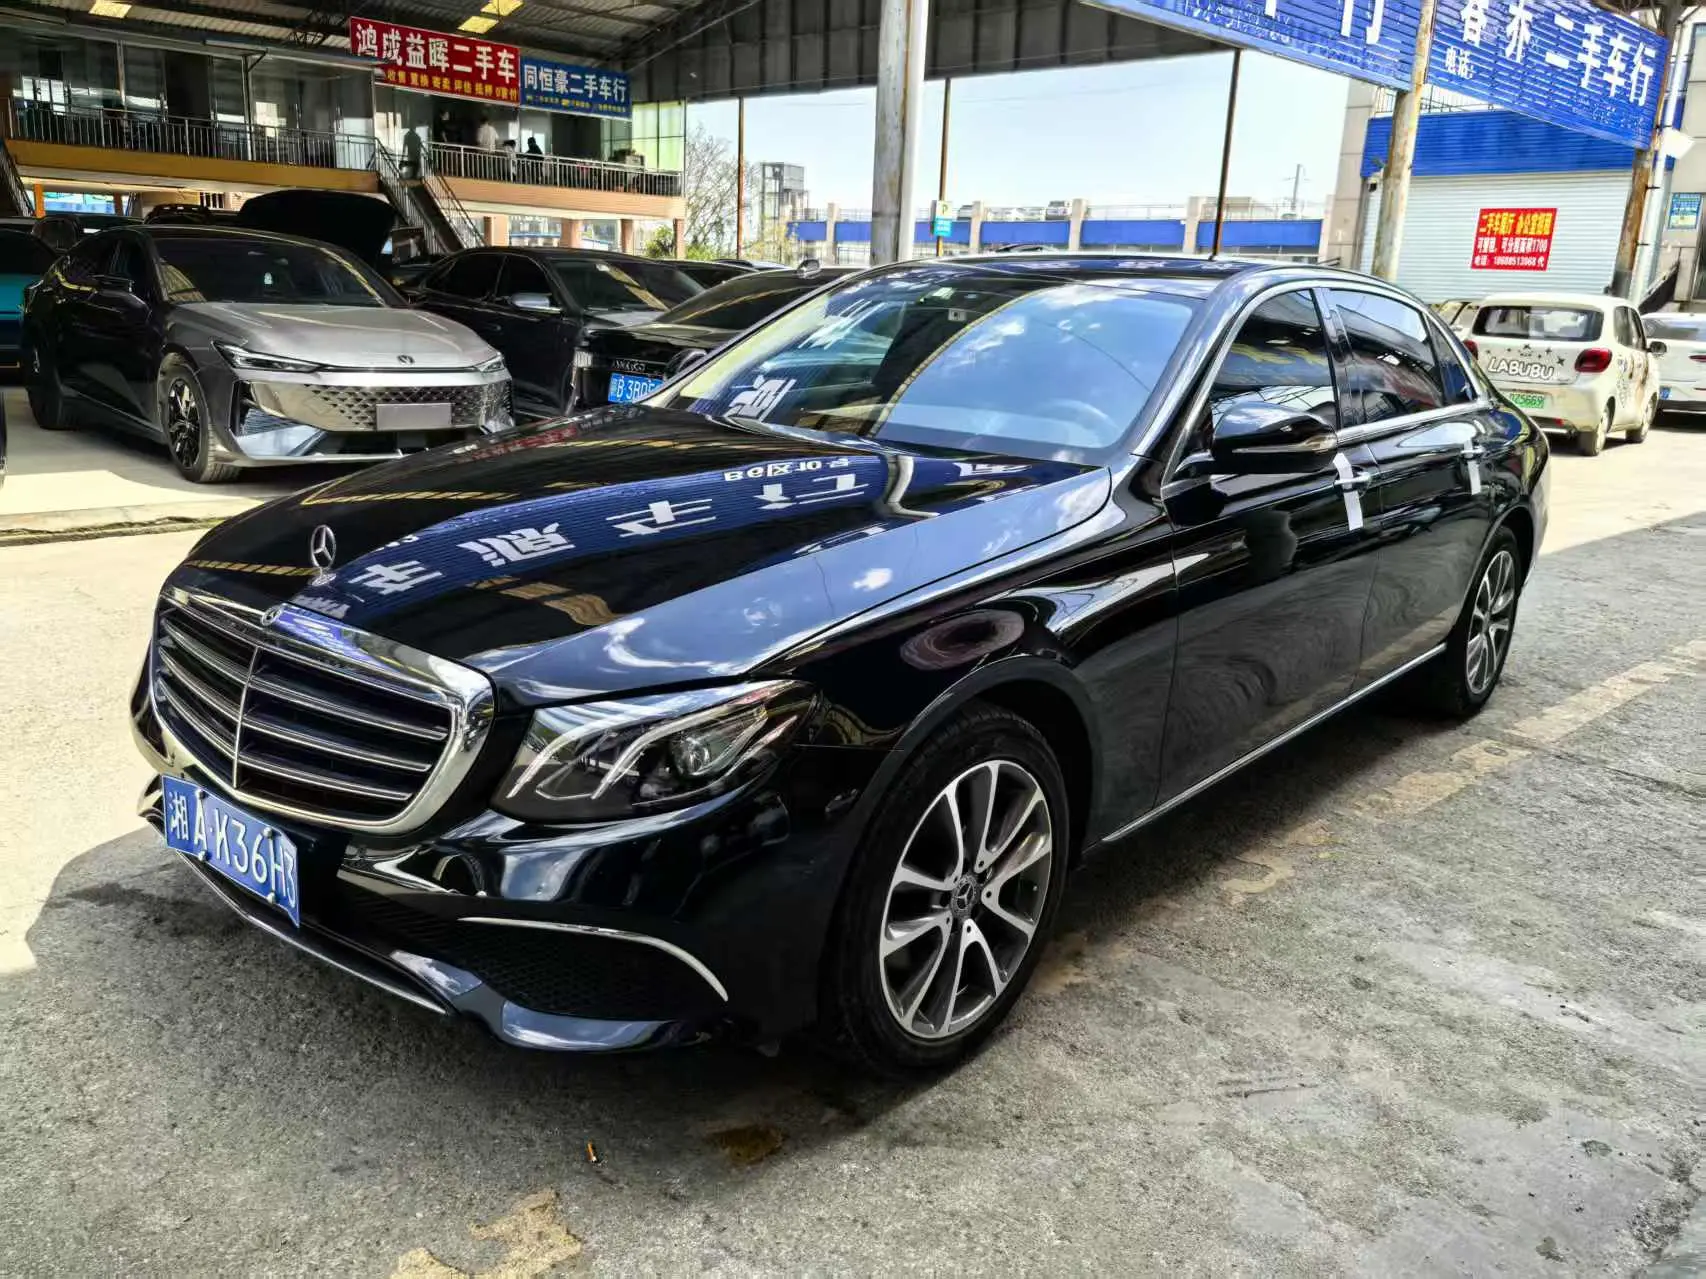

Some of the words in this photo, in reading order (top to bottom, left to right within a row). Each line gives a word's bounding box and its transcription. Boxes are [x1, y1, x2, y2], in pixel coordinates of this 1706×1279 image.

[523, 63, 627, 103] 同恒豪二手车行
[1487, 356, 1555, 380] LABUBU
